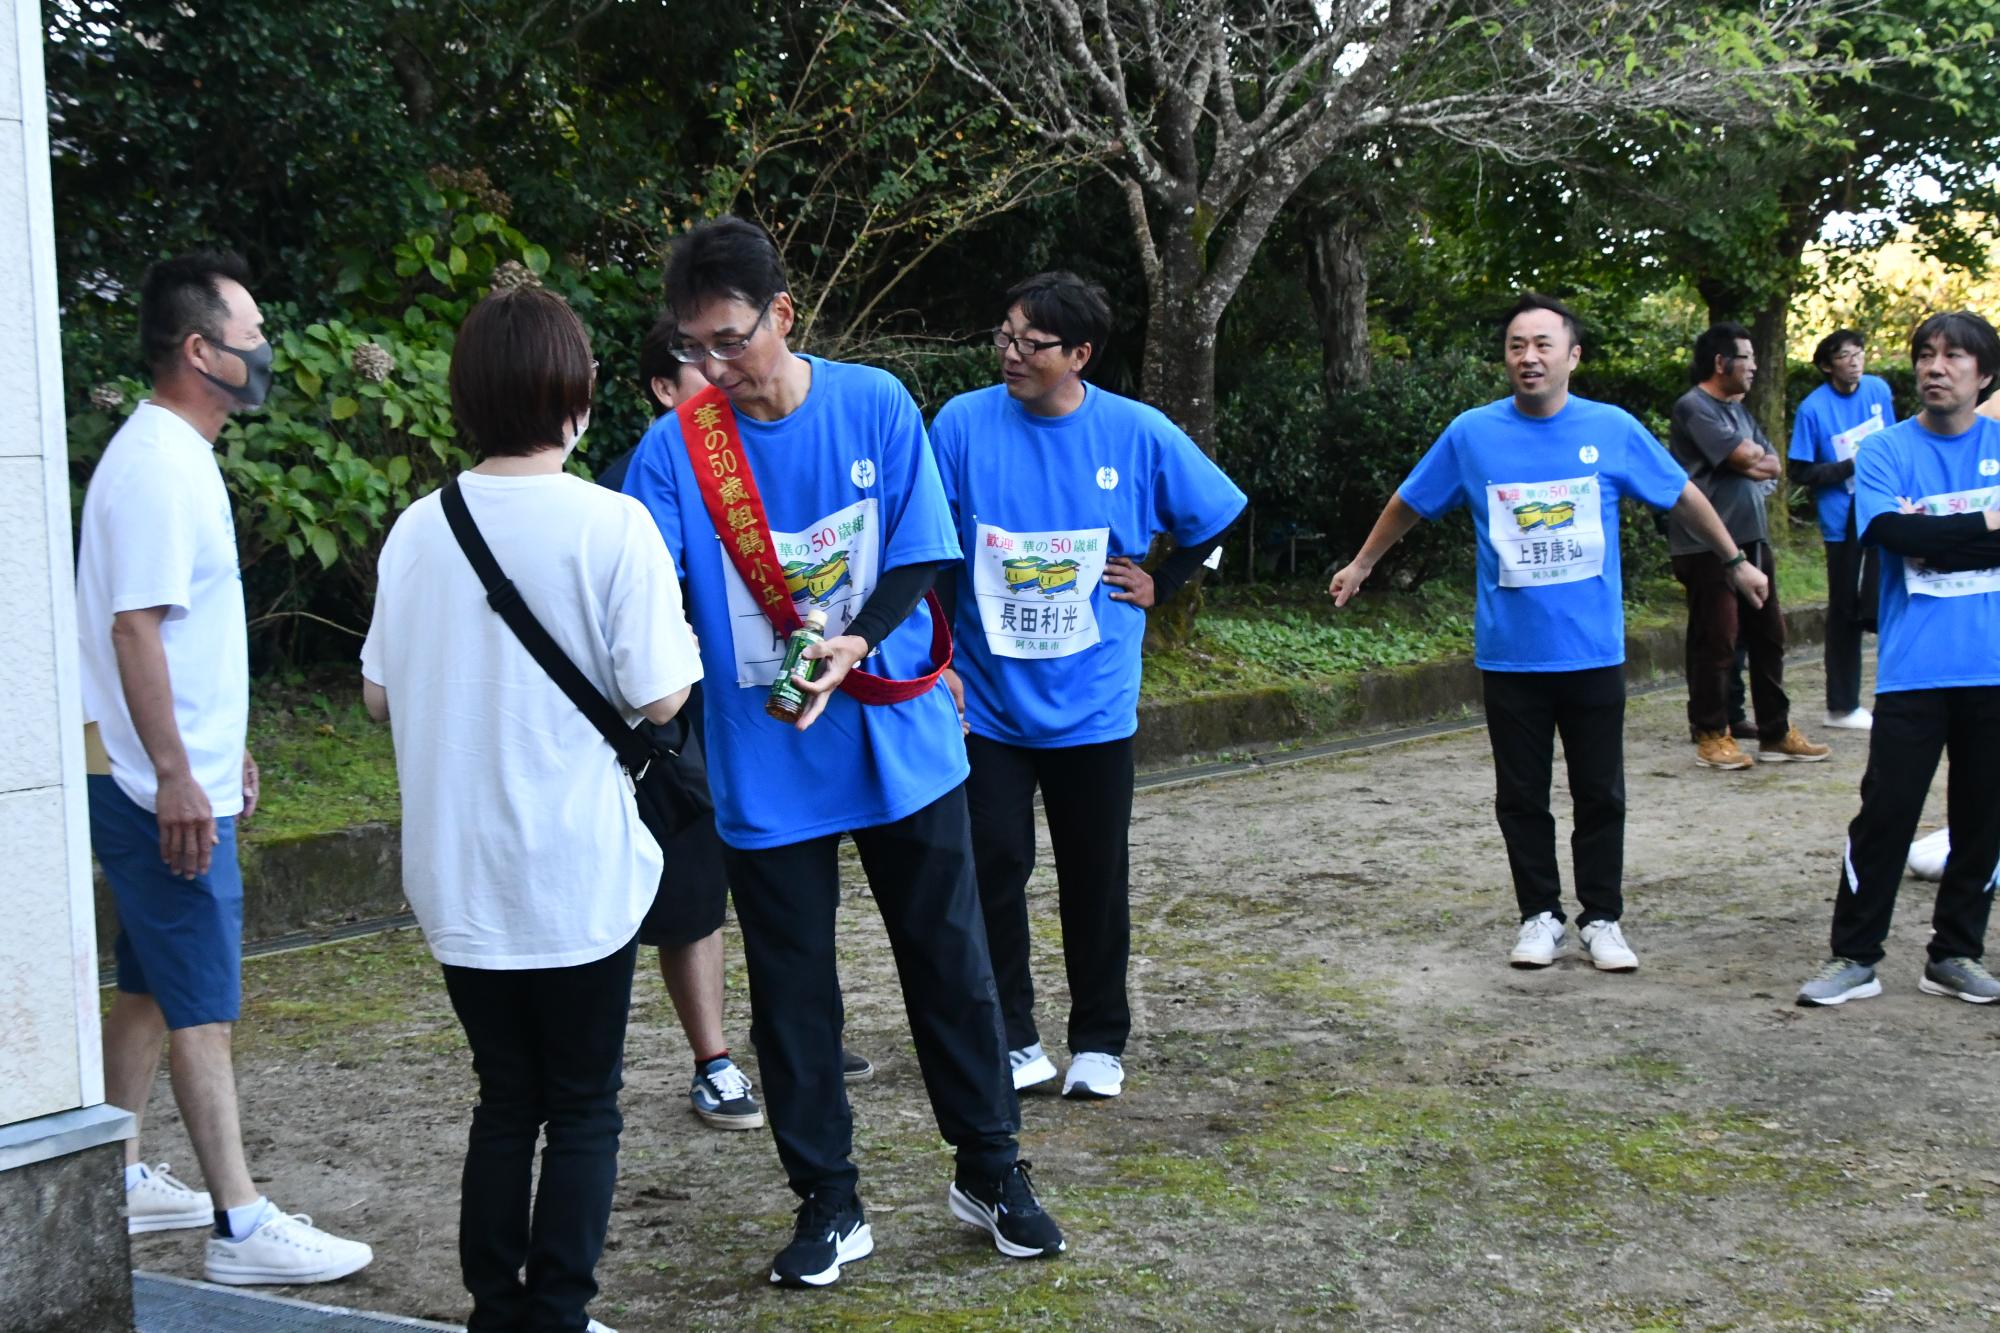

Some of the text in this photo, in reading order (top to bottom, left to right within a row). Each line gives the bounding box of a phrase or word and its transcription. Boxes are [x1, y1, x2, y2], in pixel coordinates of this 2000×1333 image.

[778, 513, 865, 558] 華の50歳組
[1023, 537, 1098, 554] 華の50歳組
[1517, 538, 1583, 565] 上野康弘
[1000, 602, 1078, 634] 長田利光
[1015, 639, 1060, 651] 阿久根市
